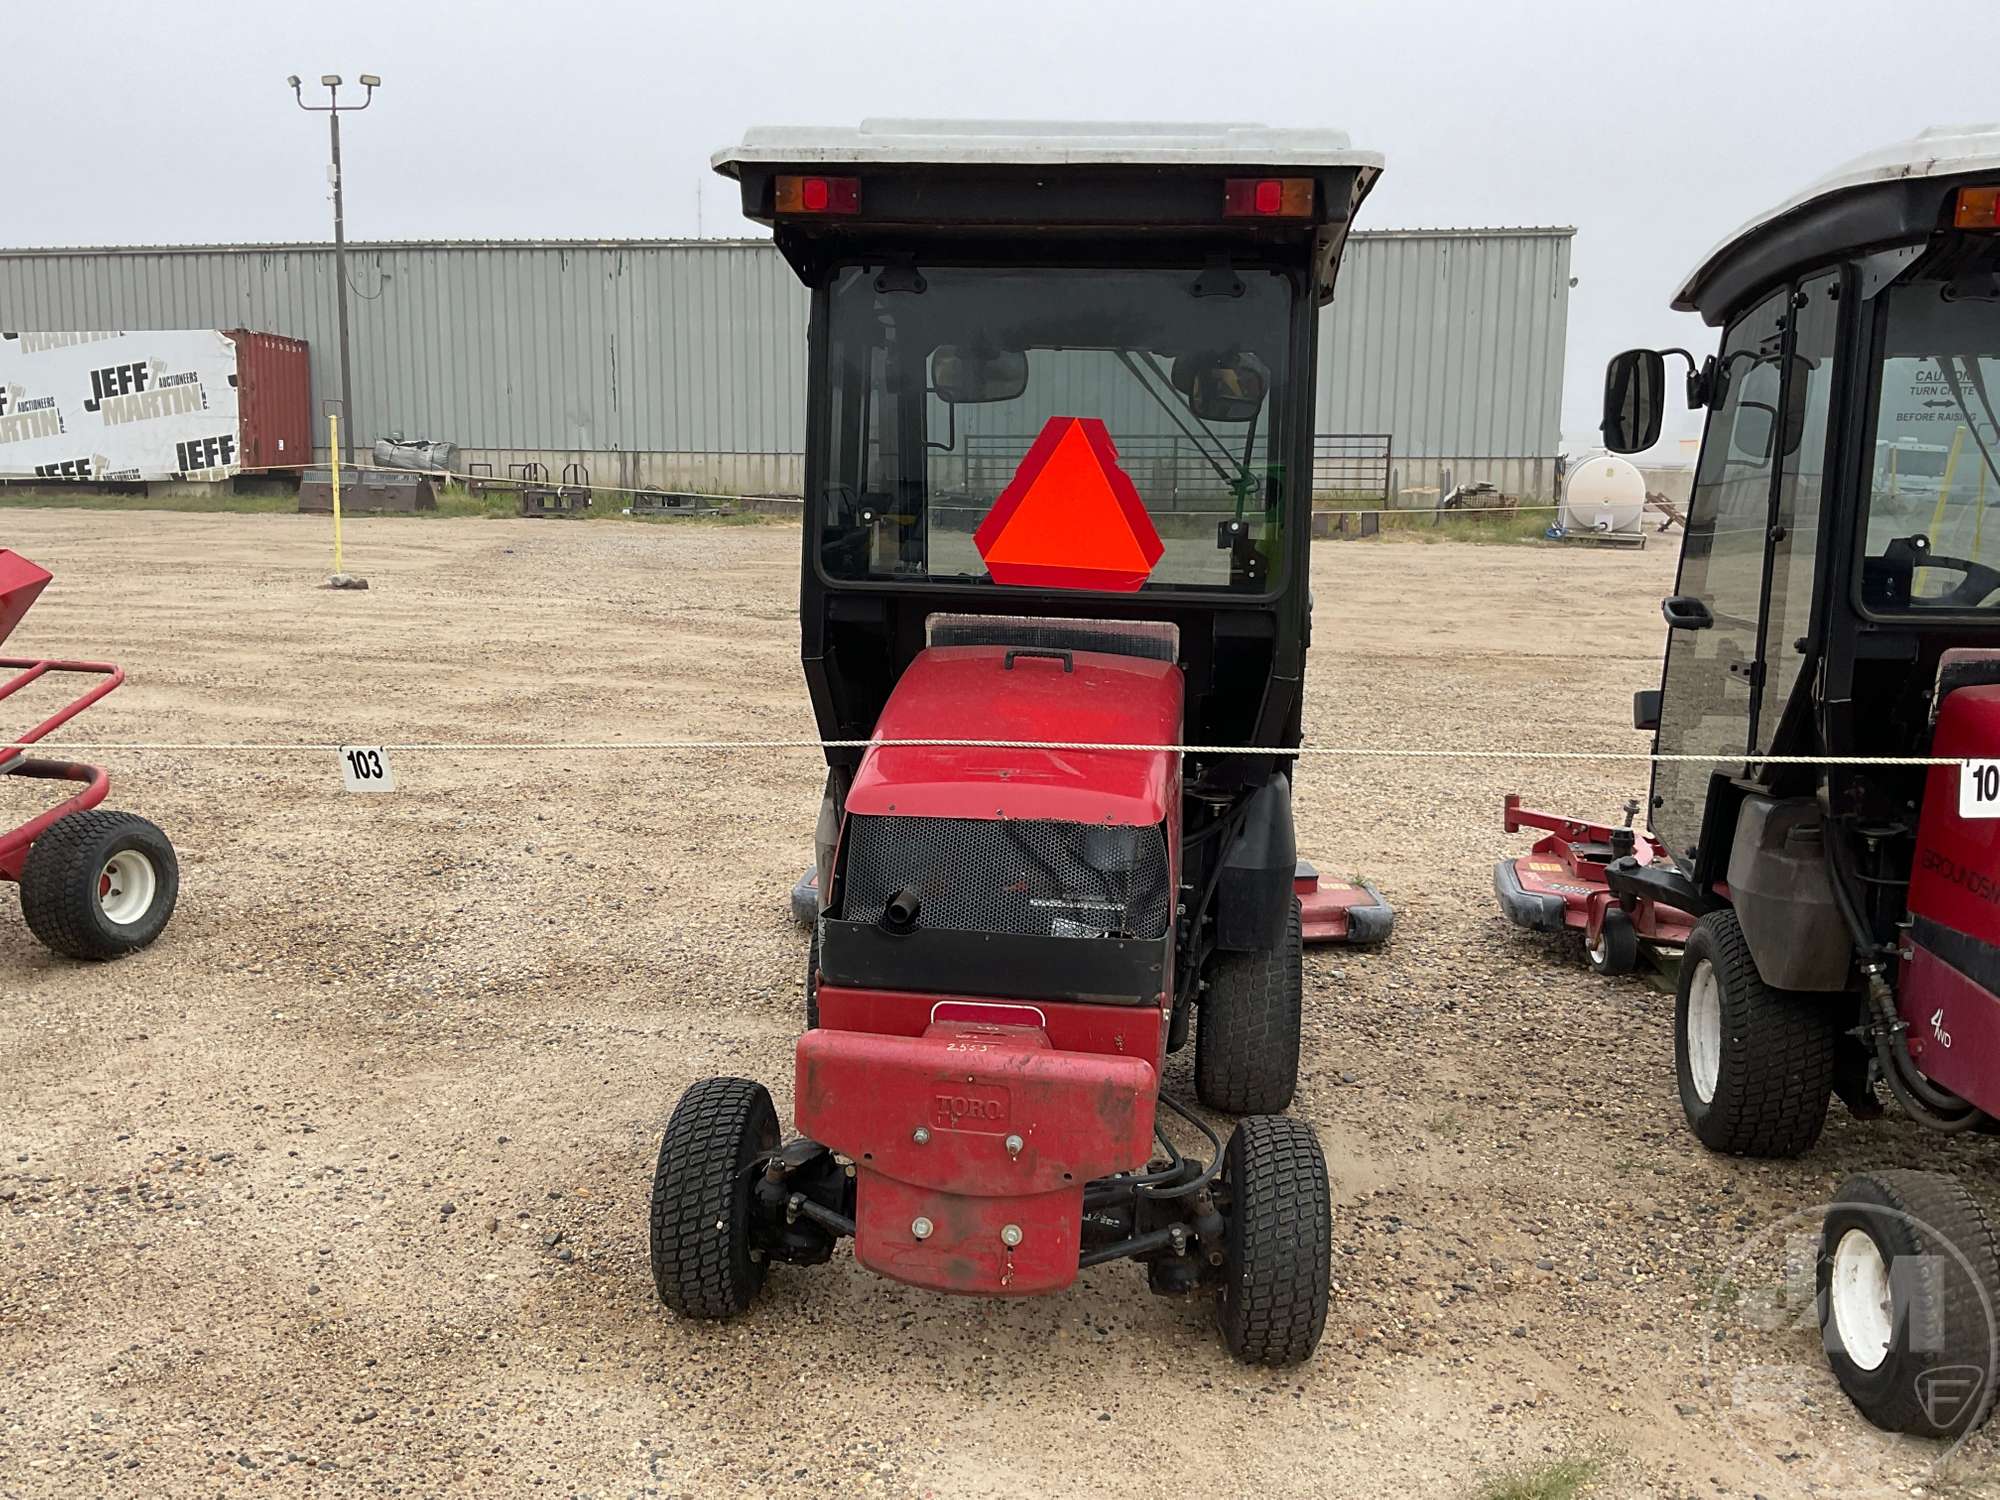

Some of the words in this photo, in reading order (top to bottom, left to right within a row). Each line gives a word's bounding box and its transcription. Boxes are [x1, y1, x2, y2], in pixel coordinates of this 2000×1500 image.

[84, 361, 149, 413] JEFF
[158, 371, 198, 388] AUCTIONEERS
[1915, 370, 1974, 382] CAUON
[101, 383, 201, 426] MARTIN
[1909, 386, 1938, 396] TURN
[1939, 386, 1976, 396] CTE
[1895, 412, 1936, 422] BEFORE
[346, 750, 383, 779] 103
[1972, 764, 1999, 802] 10
[1930, 1008, 1952, 1048] 4WD
[935, 1094, 1005, 1120] TORO
